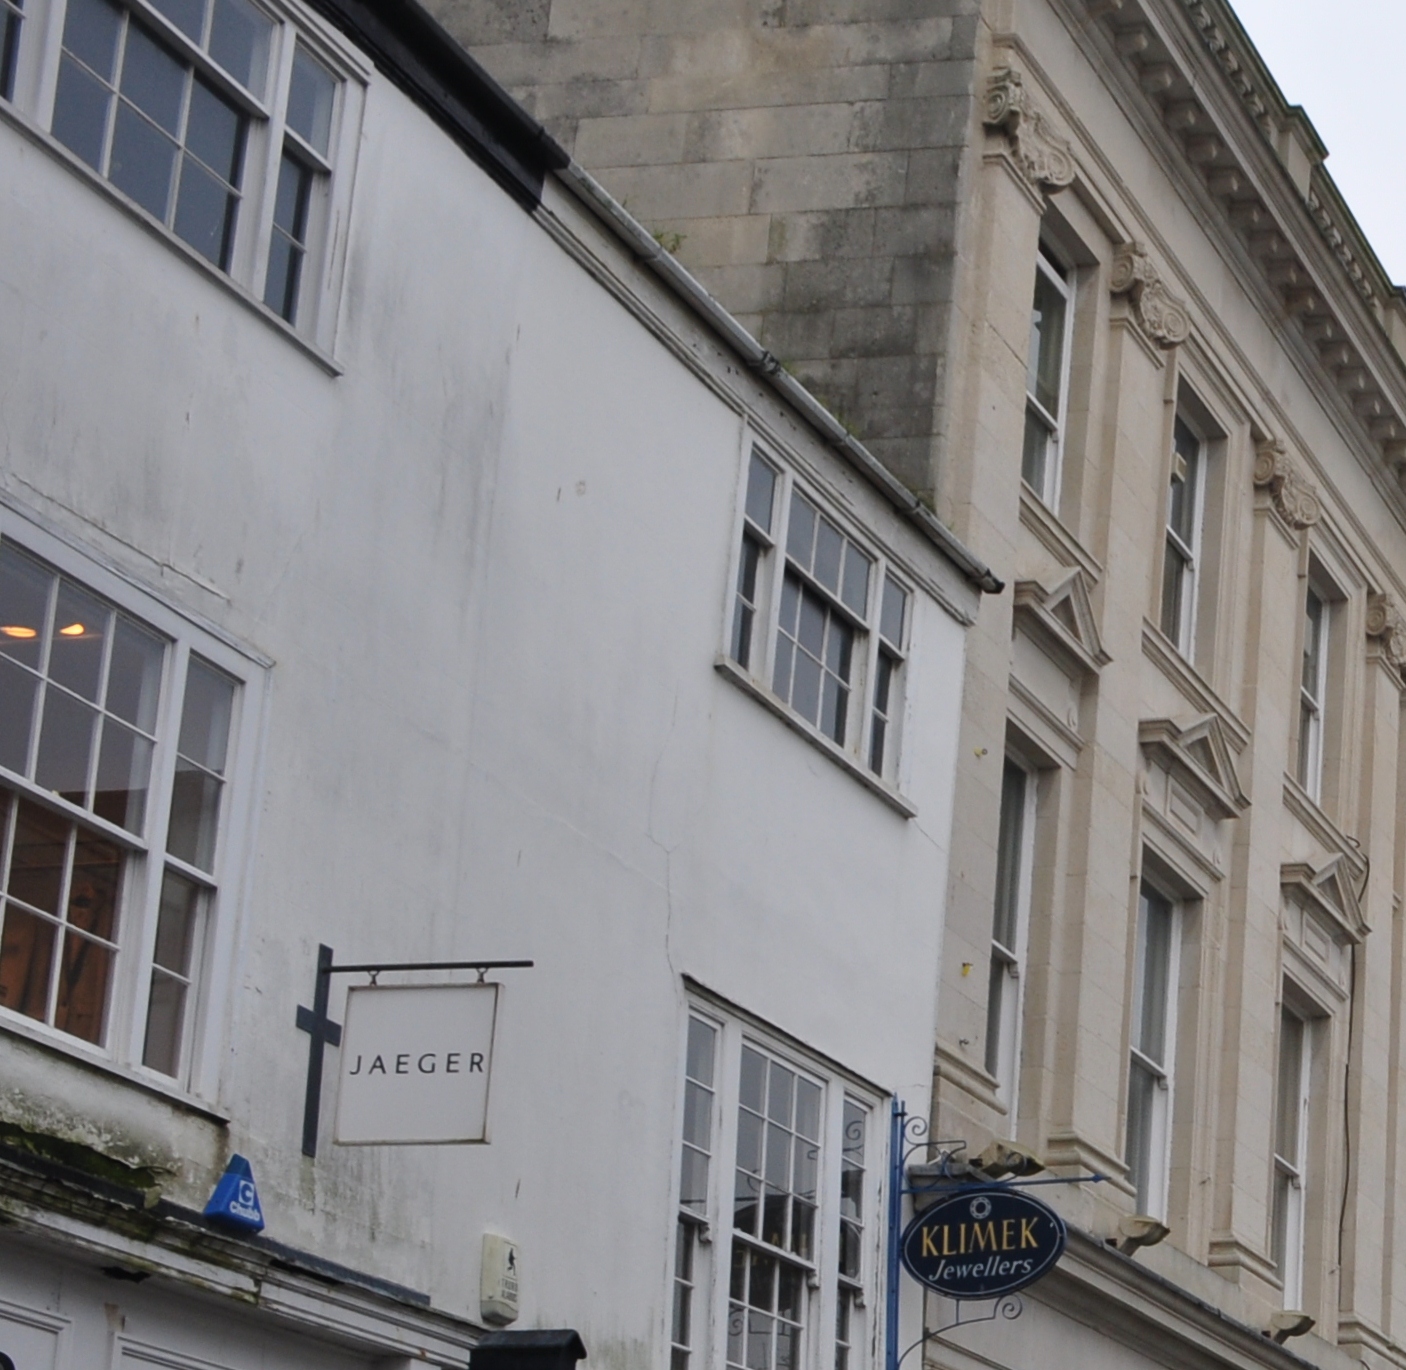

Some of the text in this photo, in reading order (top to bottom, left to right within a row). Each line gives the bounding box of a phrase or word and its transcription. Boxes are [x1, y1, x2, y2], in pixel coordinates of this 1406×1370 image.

[349, 1052, 485, 1076] JAEGER
[229, 1200, 261, 1222] Chubb
[921, 1216, 1039, 1258] KLIMEK
[928, 1255, 1034, 1282] Jewellers
